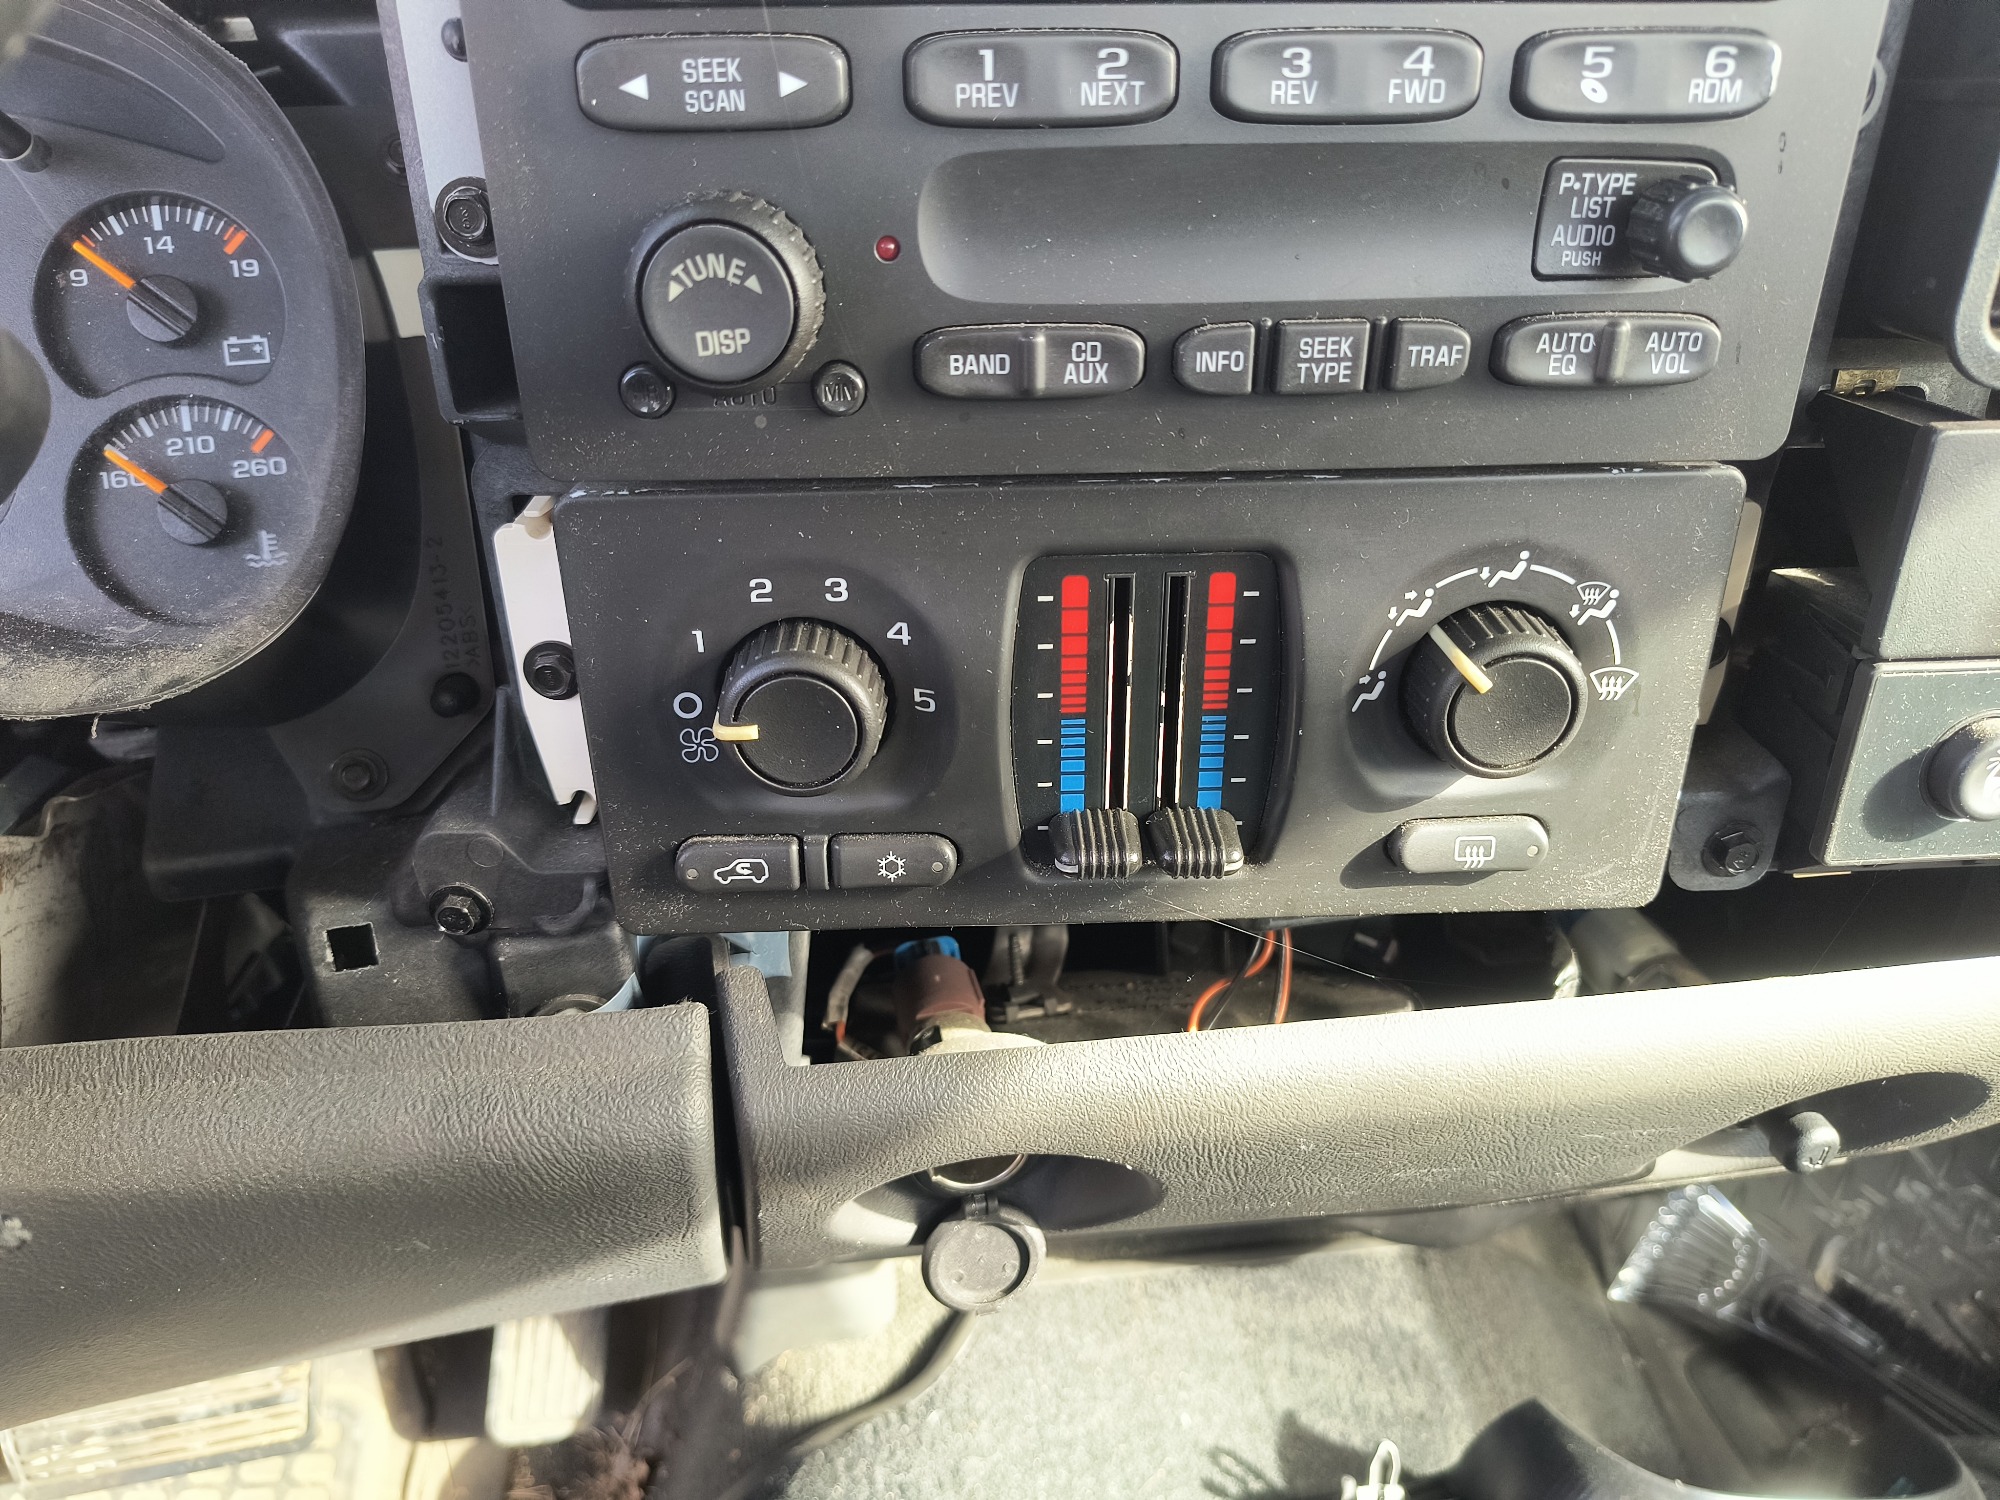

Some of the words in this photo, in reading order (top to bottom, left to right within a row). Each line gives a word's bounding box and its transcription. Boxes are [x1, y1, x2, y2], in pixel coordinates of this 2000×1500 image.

[682, 57, 741, 83] SEEK
[979, 49, 994, 81] 1
[1097, 48, 1128, 79] 2
[1282, 47, 1312, 78] 3
[1402, 46, 1435, 77] 4
[1582, 46, 1614, 77] 5
[1705, 46, 1738, 78] 6
[684, 88, 746, 112] SCAN
[955, 82, 1018, 108] PREV
[1080, 80, 1145, 106] NEXT
[1270, 78, 1318, 105] REV
[1388, 78, 1446, 103] FWD
[1688, 78, 1743, 104] RDM
[1570, 196, 1617, 218] LIST
[143, 235, 175, 255] 14
[1550, 224, 1616, 247] AUDIO
[228, 258, 260, 278] 19
[670, 252, 747, 288] TUNE
[1561, 250, 1602, 267] PUSH
[69, 268, 89, 287] 9
[695, 327, 751, 357] DISP
[1071, 341, 1102, 362] CD
[1299, 336, 1354, 359] SEEK
[1535, 332, 1593, 354] AUTO
[1645, 331, 1703, 353] AUTO
[949, 353, 1011, 376] BAND
[1195, 350, 1245, 373] INFO
[1407, 345, 1464, 368] TRAF
[1548, 355, 1577, 377] EQ
[1651, 354, 1690, 375] VOL
[1063, 362, 1109, 385] AUX
[1297, 361, 1353, 384] TYPE
[165, 435, 216, 457] 210
[231, 456, 288, 479] 260
[749, 578, 773, 603] 2
[824, 577, 849, 602] 3
[691, 629, 705, 653] 1
[886, 621, 912, 646] 4
[913, 687, 936, 713] 5
